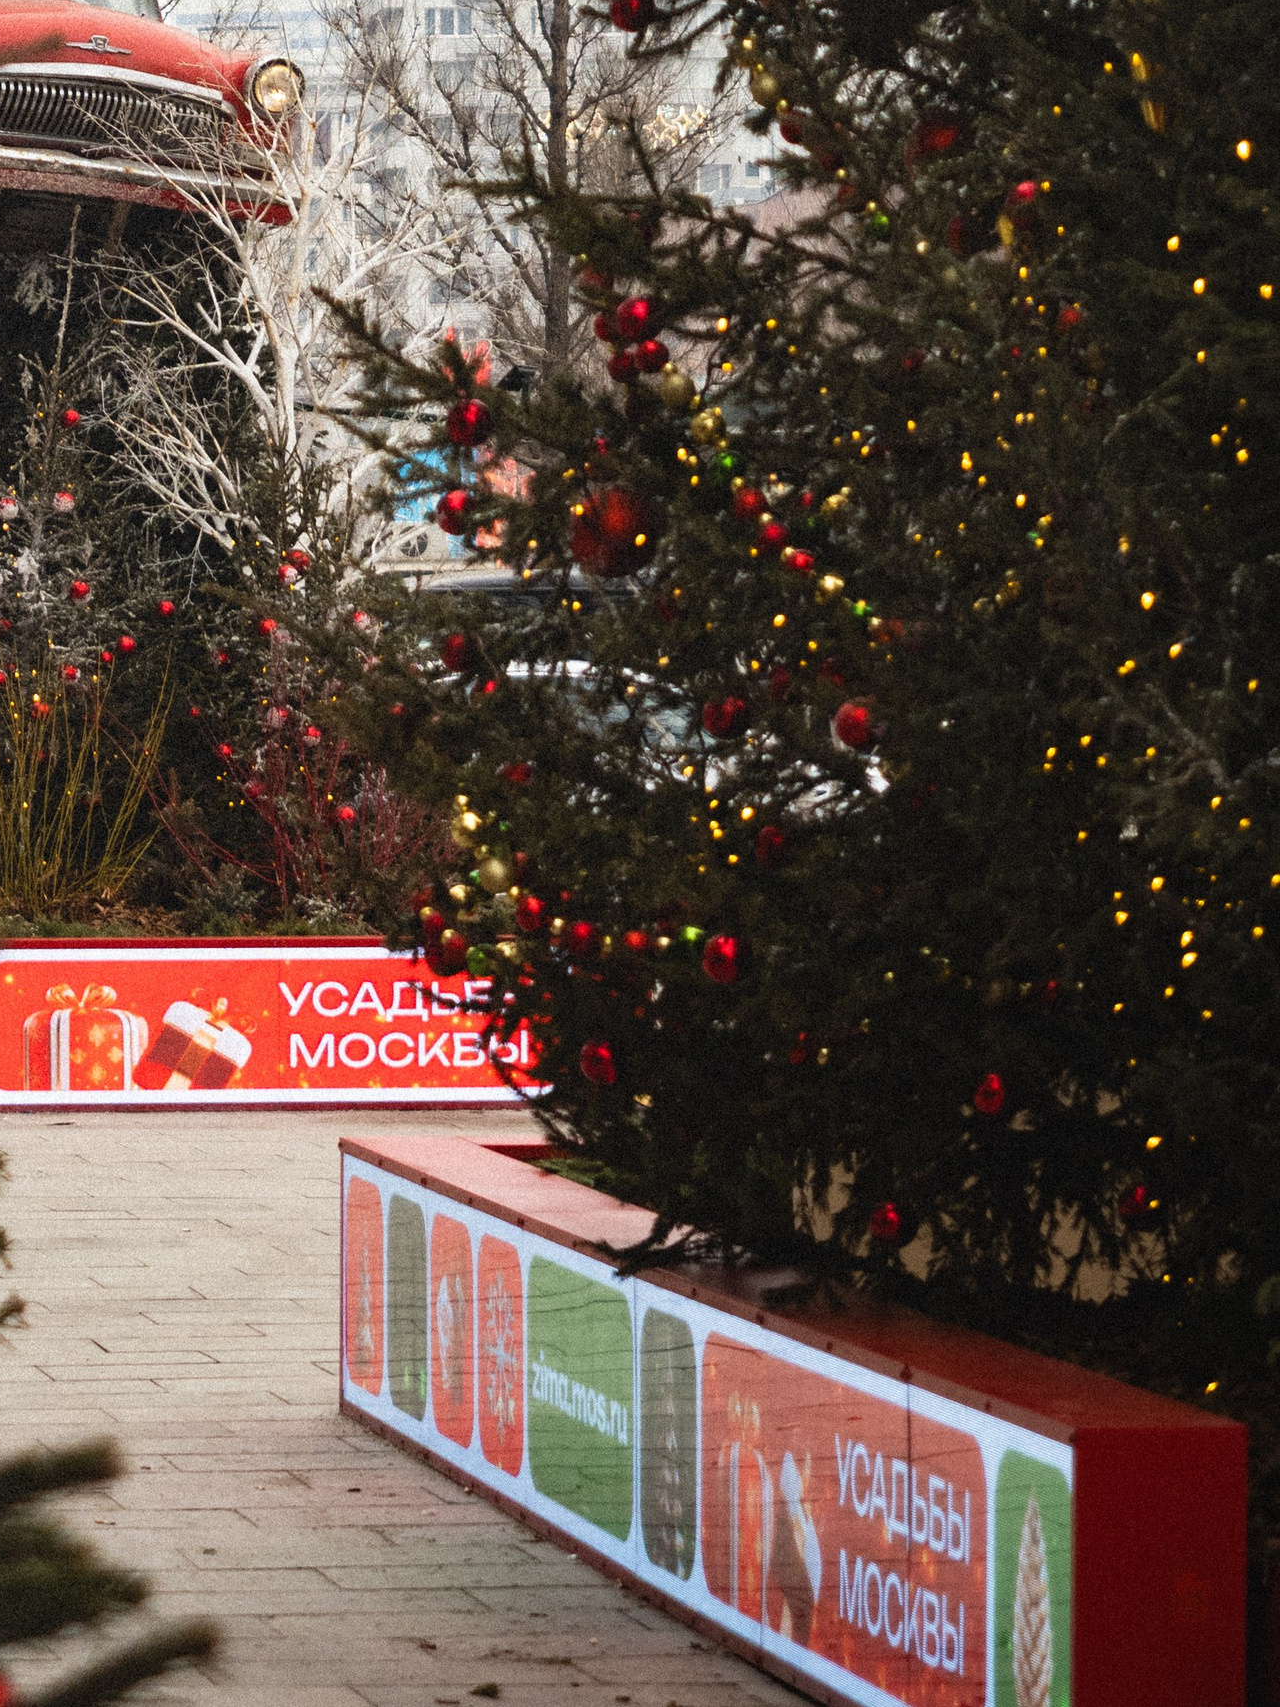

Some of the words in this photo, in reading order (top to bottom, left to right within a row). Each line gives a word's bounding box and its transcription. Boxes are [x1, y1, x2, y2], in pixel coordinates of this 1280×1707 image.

[289, 1029, 529, 1068] МОСКВЫ
[532, 1349, 628, 1446] zima.mos.ru
[834, 1432, 970, 1565] УСАДЬБЫ
[838, 1547, 965, 1678] МОСКВЫ
